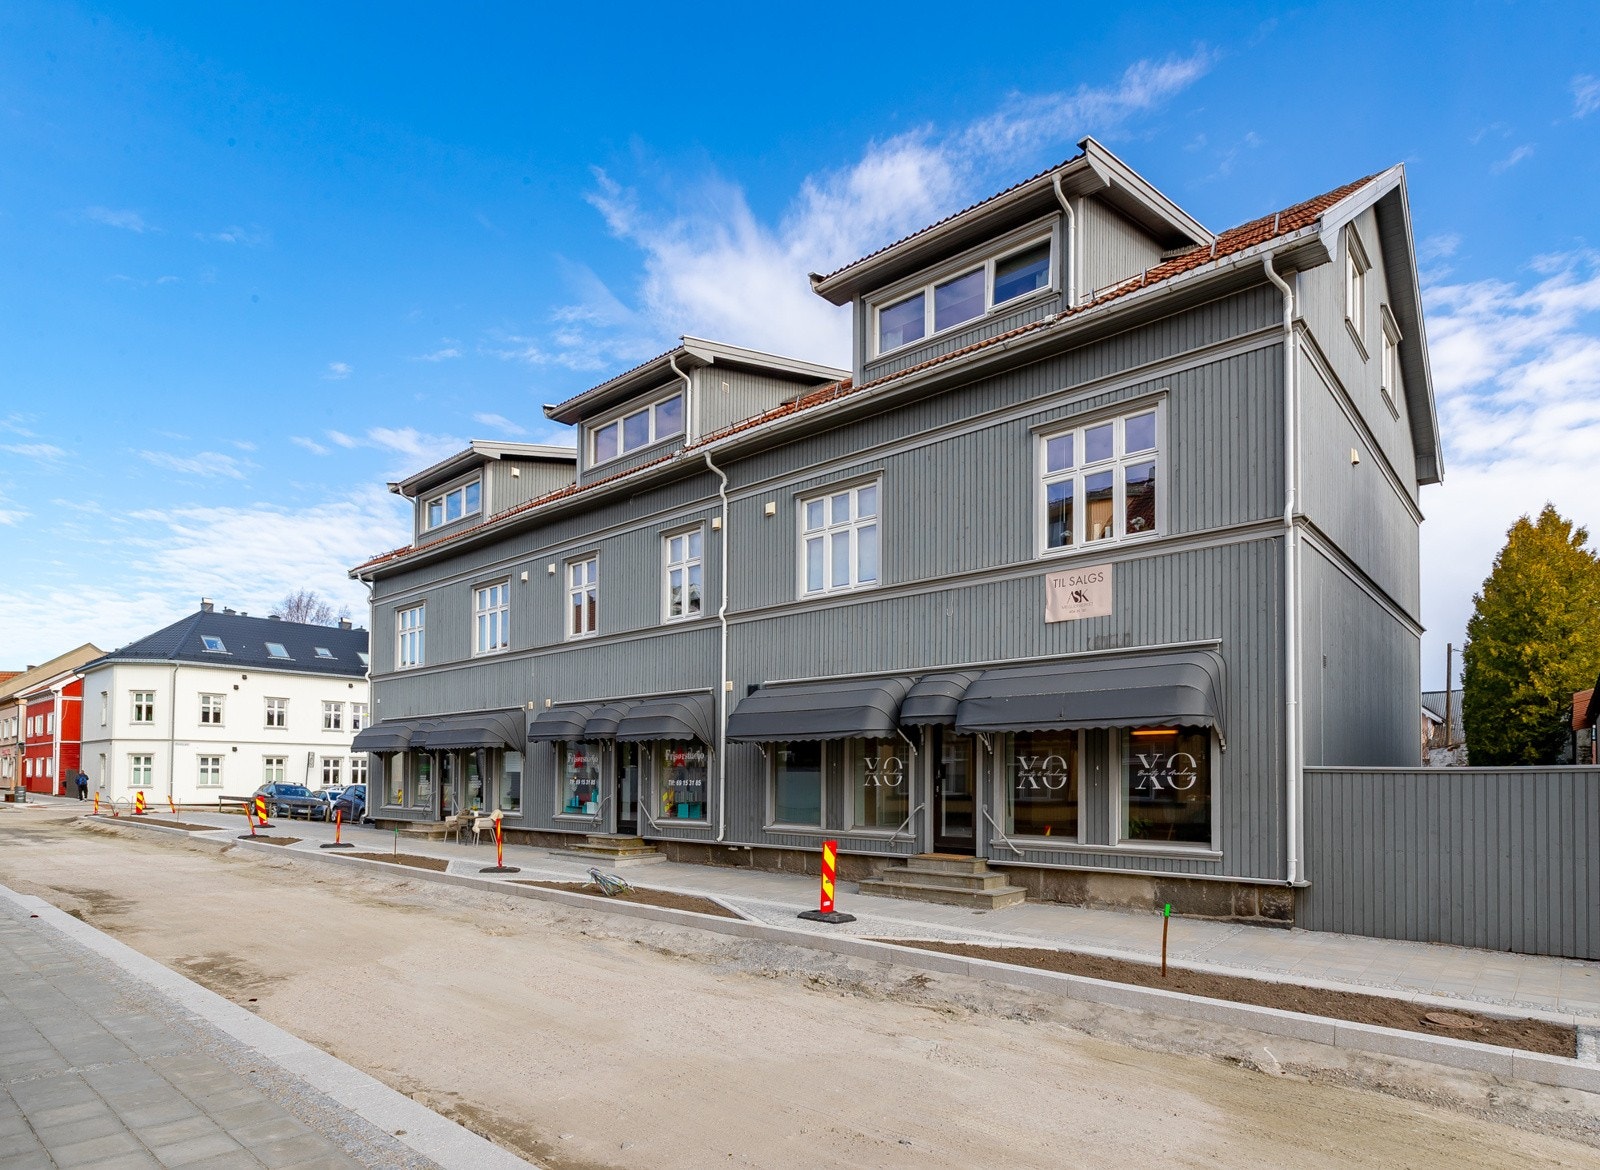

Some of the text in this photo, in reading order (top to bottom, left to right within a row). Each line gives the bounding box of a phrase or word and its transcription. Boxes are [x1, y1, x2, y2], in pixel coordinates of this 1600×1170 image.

[1053, 572, 1104, 588] TIL SALGS
[863, 756, 903, 787] XO
[1016, 755, 1067, 789] XO
[1135, 752, 1197, 790] XO
